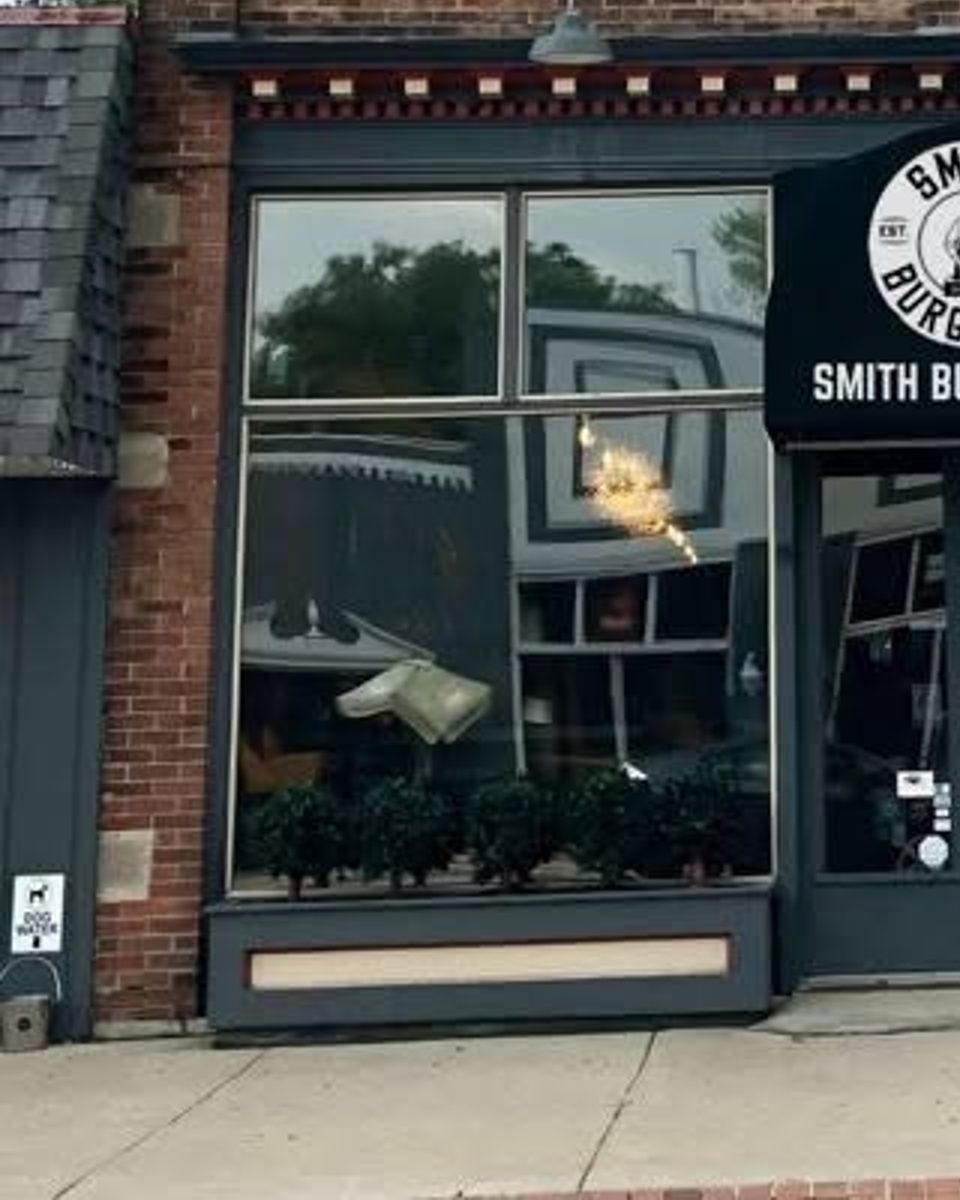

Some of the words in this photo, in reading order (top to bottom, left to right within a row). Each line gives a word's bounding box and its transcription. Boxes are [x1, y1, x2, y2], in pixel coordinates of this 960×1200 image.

[812, 362, 918, 402] SMITH
[24, 911, 51, 923] DOG
[17, 923, 57, 936] WATER
